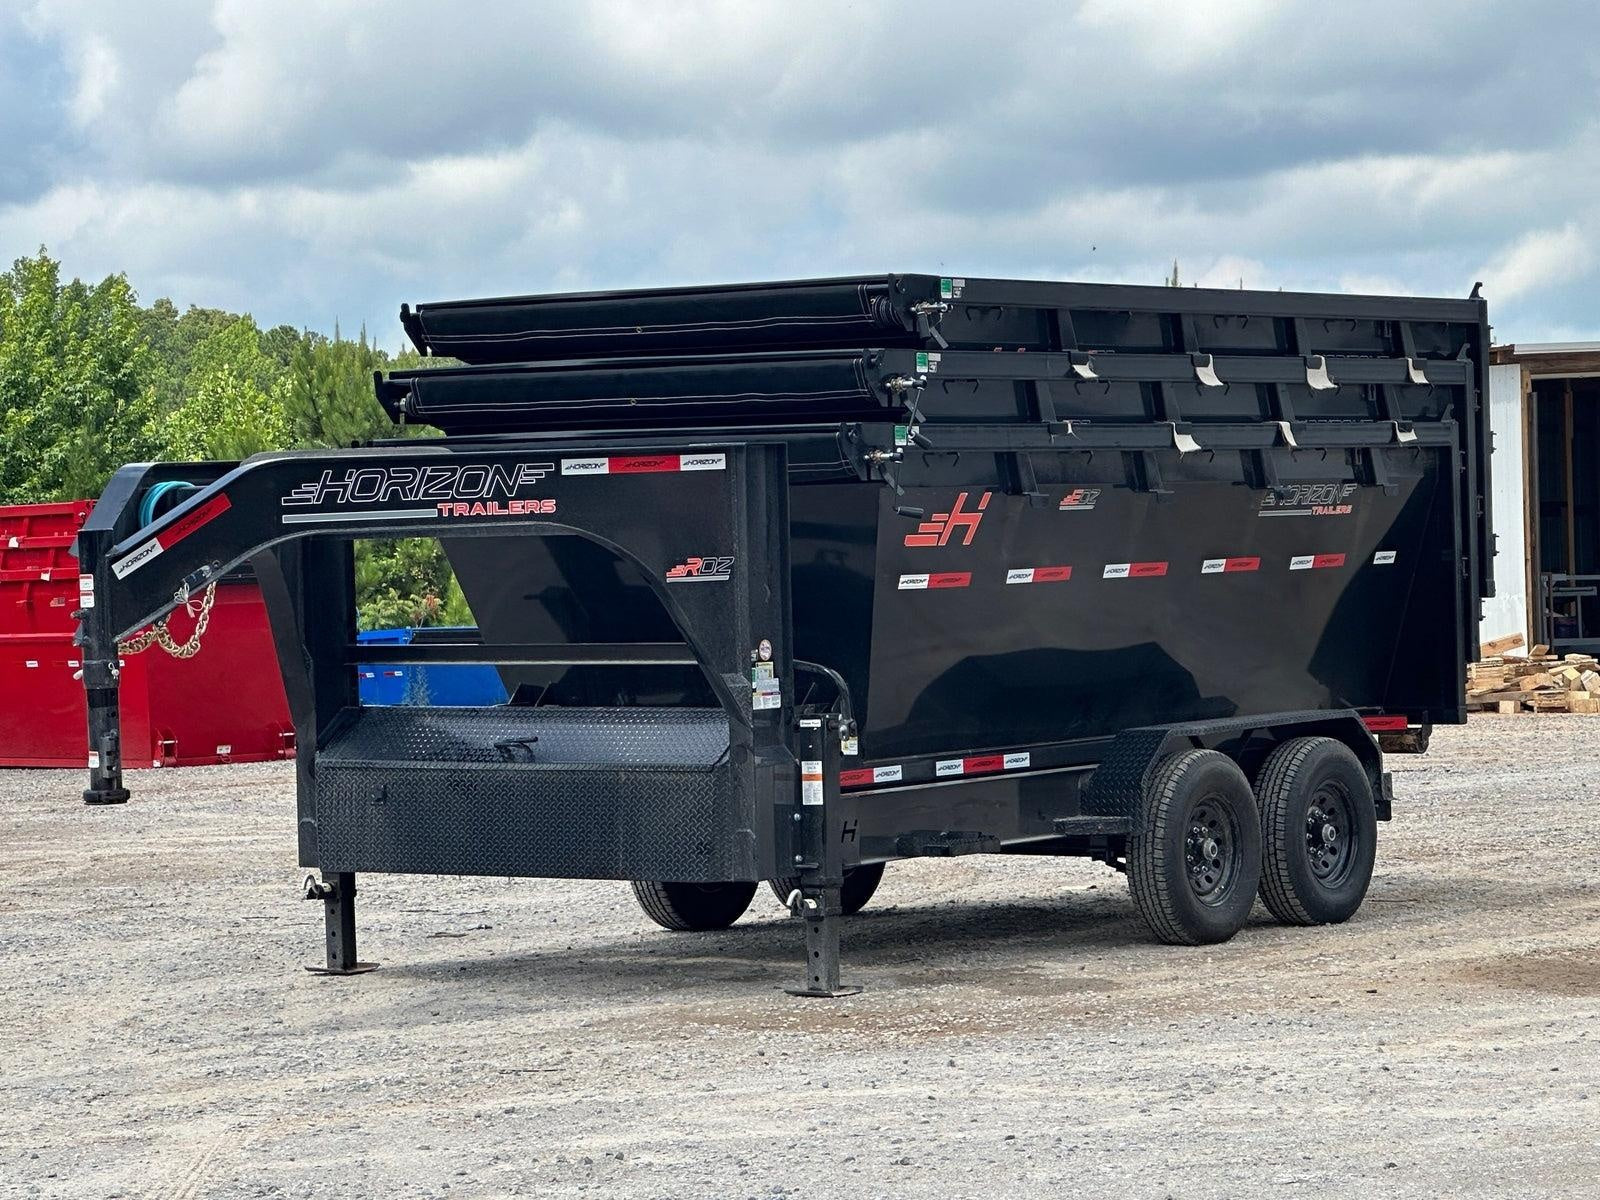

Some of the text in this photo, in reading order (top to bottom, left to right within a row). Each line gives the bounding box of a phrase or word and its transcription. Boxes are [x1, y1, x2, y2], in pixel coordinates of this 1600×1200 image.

[564, 462, 606, 470] HORIZON
[682, 458, 723, 467] HORIZON
[314, 464, 524, 504] HORIZON
[437, 500, 556, 517] TRAILERS
[1312, 505, 1353, 515] TRAILERS
[118, 543, 157, 574] HORIZON
[682, 557, 735, 576] RDZ
